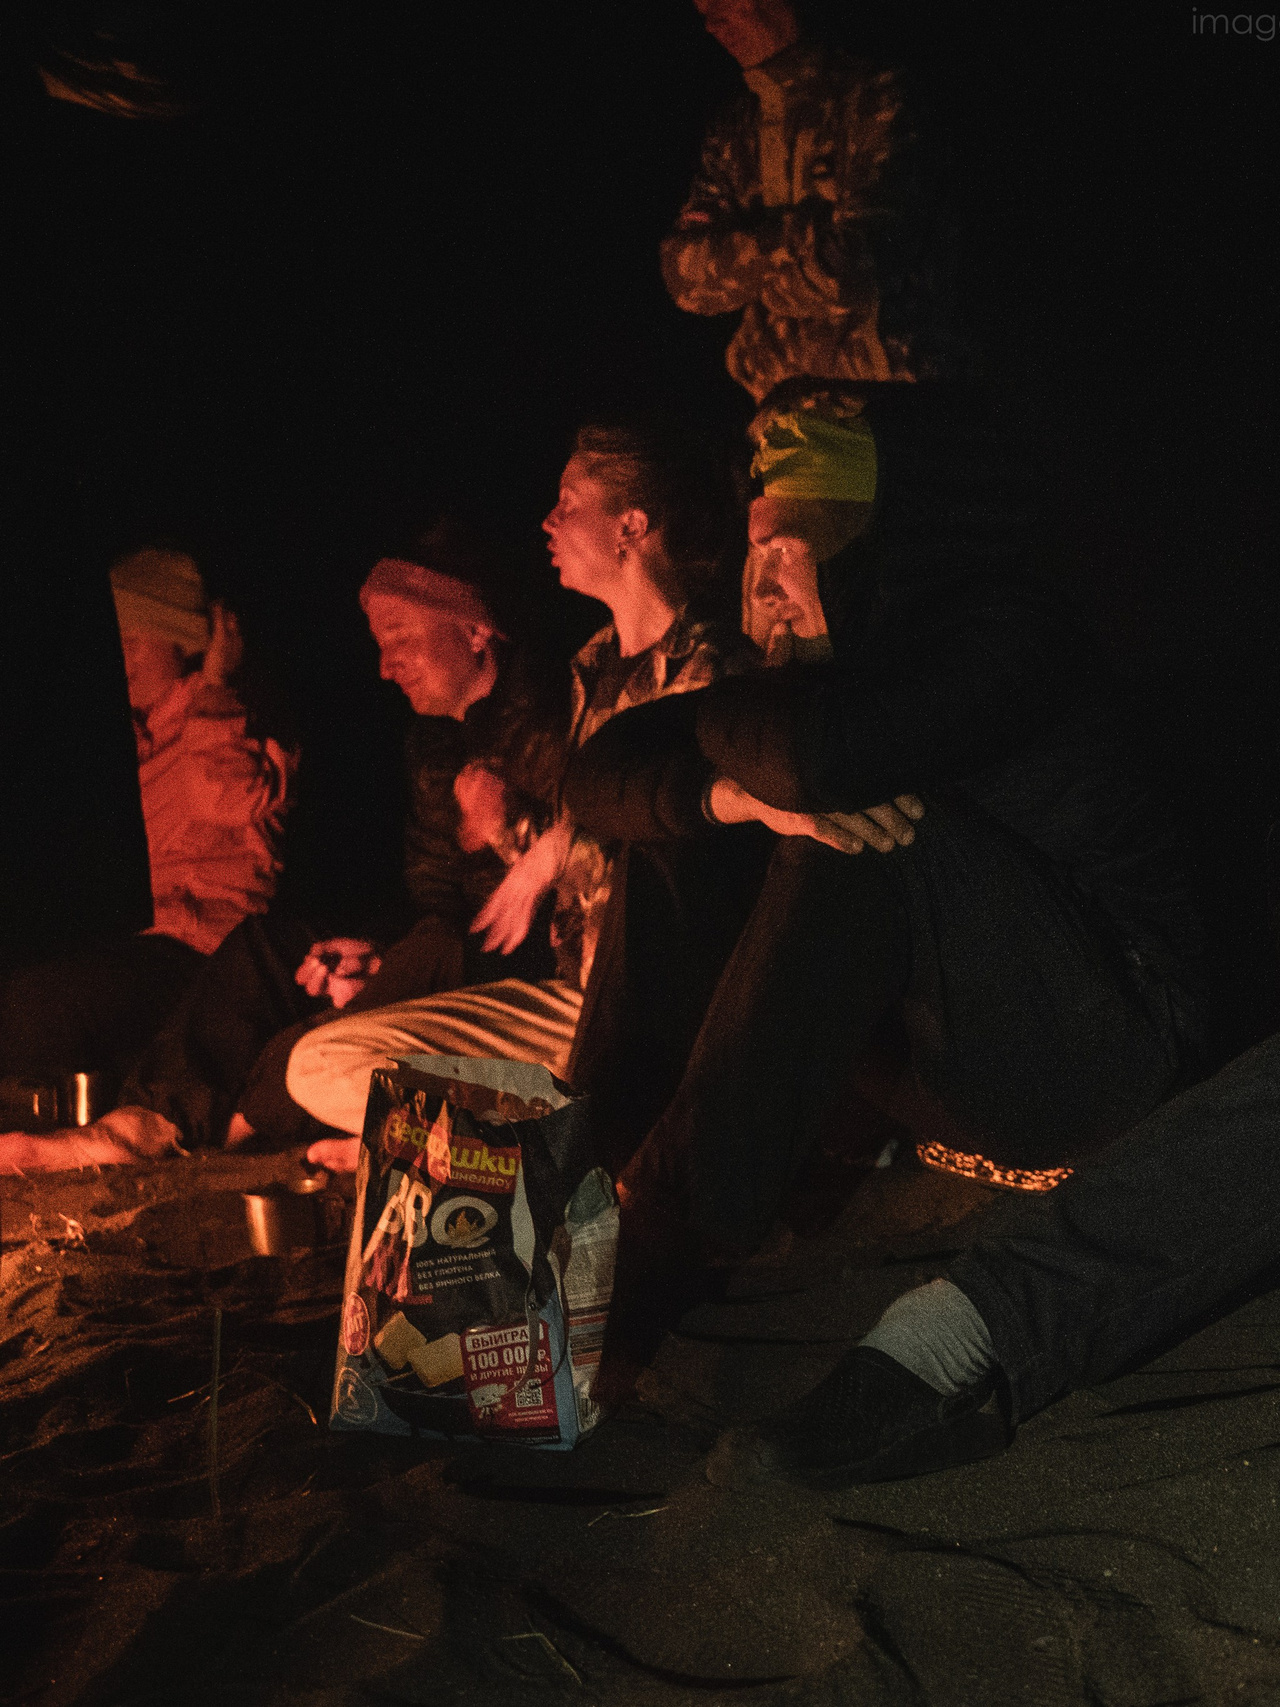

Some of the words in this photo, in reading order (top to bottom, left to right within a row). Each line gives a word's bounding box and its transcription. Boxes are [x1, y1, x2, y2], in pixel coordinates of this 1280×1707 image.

[416, 1260, 435, 1269] 100%
[417, 1271, 433, 1280] БЕЗ
[435, 1265, 473, 1277] ГЛЮТЕНА
[418, 1282, 434, 1292] БЕЗ
[436, 1275, 473, 1288] ЯИЧНОГО
[475, 1270, 502, 1281] БЕЛКА
[471, 1328, 531, 1349] ВЫИГРА
[468, 1350, 499, 1371] 100
[470, 1373, 478, 1381] И
[480, 1366, 514, 1381] ДРУГИЕ
[516, 1363, 549, 1376] ПРЗЫ
